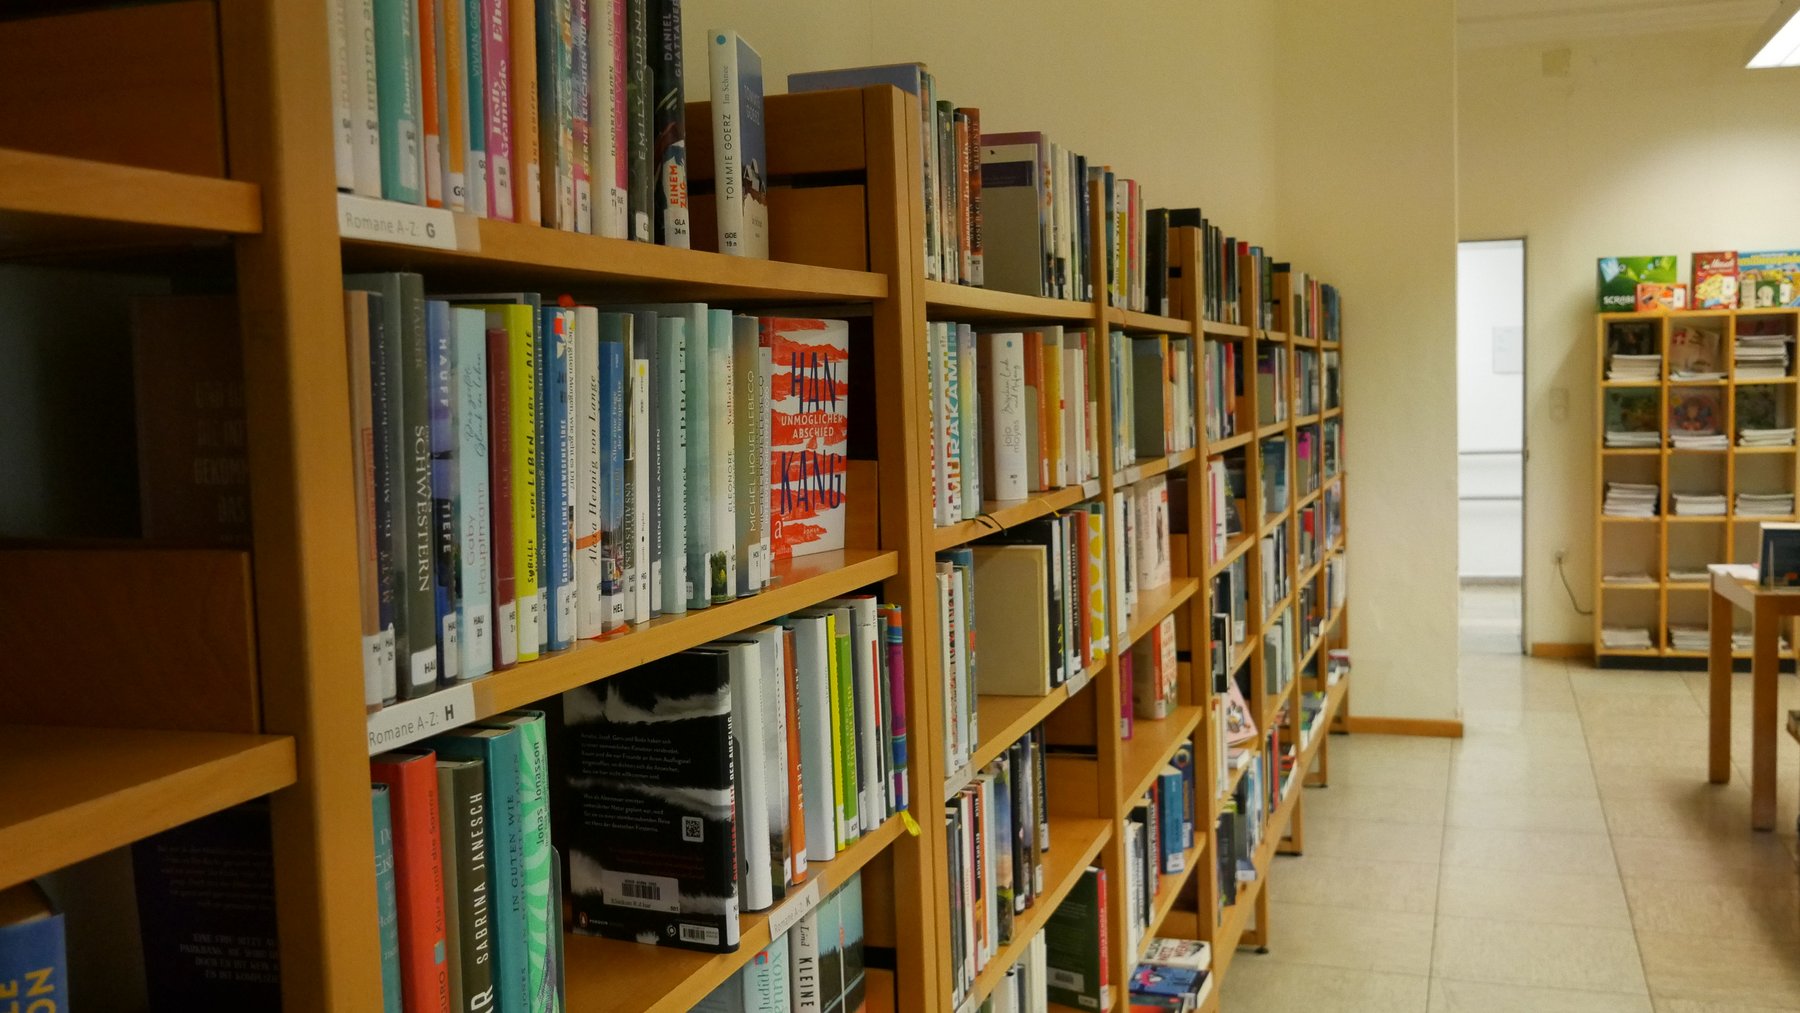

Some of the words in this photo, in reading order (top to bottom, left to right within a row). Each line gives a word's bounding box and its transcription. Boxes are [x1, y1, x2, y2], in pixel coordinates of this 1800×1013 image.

[580, 15, 588, 45] NUR
[662, 13, 674, 61] DANIEL
[472, 34, 482, 76] VIVIAN
[580, 51, 588, 122] LEUCHTEN
[721, 65, 730, 92] Schnee
[723, 93, 731, 105] Im
[491, 80, 503, 135] Holly
[498, 59, 510, 158] Gramazio
[637, 95, 646, 160] EMILY
[723, 113, 733, 150] GOERZ
[669, 164, 679, 206] EINEM
[679, 181, 687, 209] ZUG
[725, 153, 735, 200] TOMMIE
[345, 212, 394, 233] Romane
[425, 223, 436, 238] G
[525, 329, 533, 368] ALLE
[438, 338, 449, 408] HAUFF
[791, 352, 837, 414] HAN
[588, 375, 598, 422] Lange
[590, 428, 598, 455] von
[747, 370, 756, 476] HOUELLEBECQ
[793, 426, 834, 440] ABSCHIED
[944, 350, 962, 505] MURAKAMI
[1012, 420, 1022, 454] moyes
[588, 460, 598, 515] Hennig
[748, 479, 757, 532] MICHEL
[780, 450, 841, 515] KANG
[414, 425, 430, 593] SCHWESTERN
[441, 501, 451, 553] TIEFE
[464, 514, 476, 566] Gaby
[477, 482, 489, 594] Hauptmann
[588, 521, 598, 563] Alexa
[381, 550, 392, 604] MATT
[613, 603, 624, 613] HEL
[368, 721, 415, 747] Romane
[416, 712, 440, 730] A-Z:
[444, 704, 455, 721] H
[532, 741, 544, 802] Jonasson
[427, 789, 437, 834] Sonne
[470, 792, 484, 873] JANESCH
[506, 794, 515, 826] WIE
[535, 807, 545, 846] Jonas
[429, 843, 437, 861] die
[508, 833, 520, 896] GUTEN
[431, 864, 439, 893] und
[433, 896, 442, 933] Klara
[474, 882, 489, 965] SABRINA
[512, 898, 520, 913] IN
[800, 925, 810, 947] Lind
[758, 968, 772, 1012] Judith
[798, 957, 815, 1008] KLEINE
